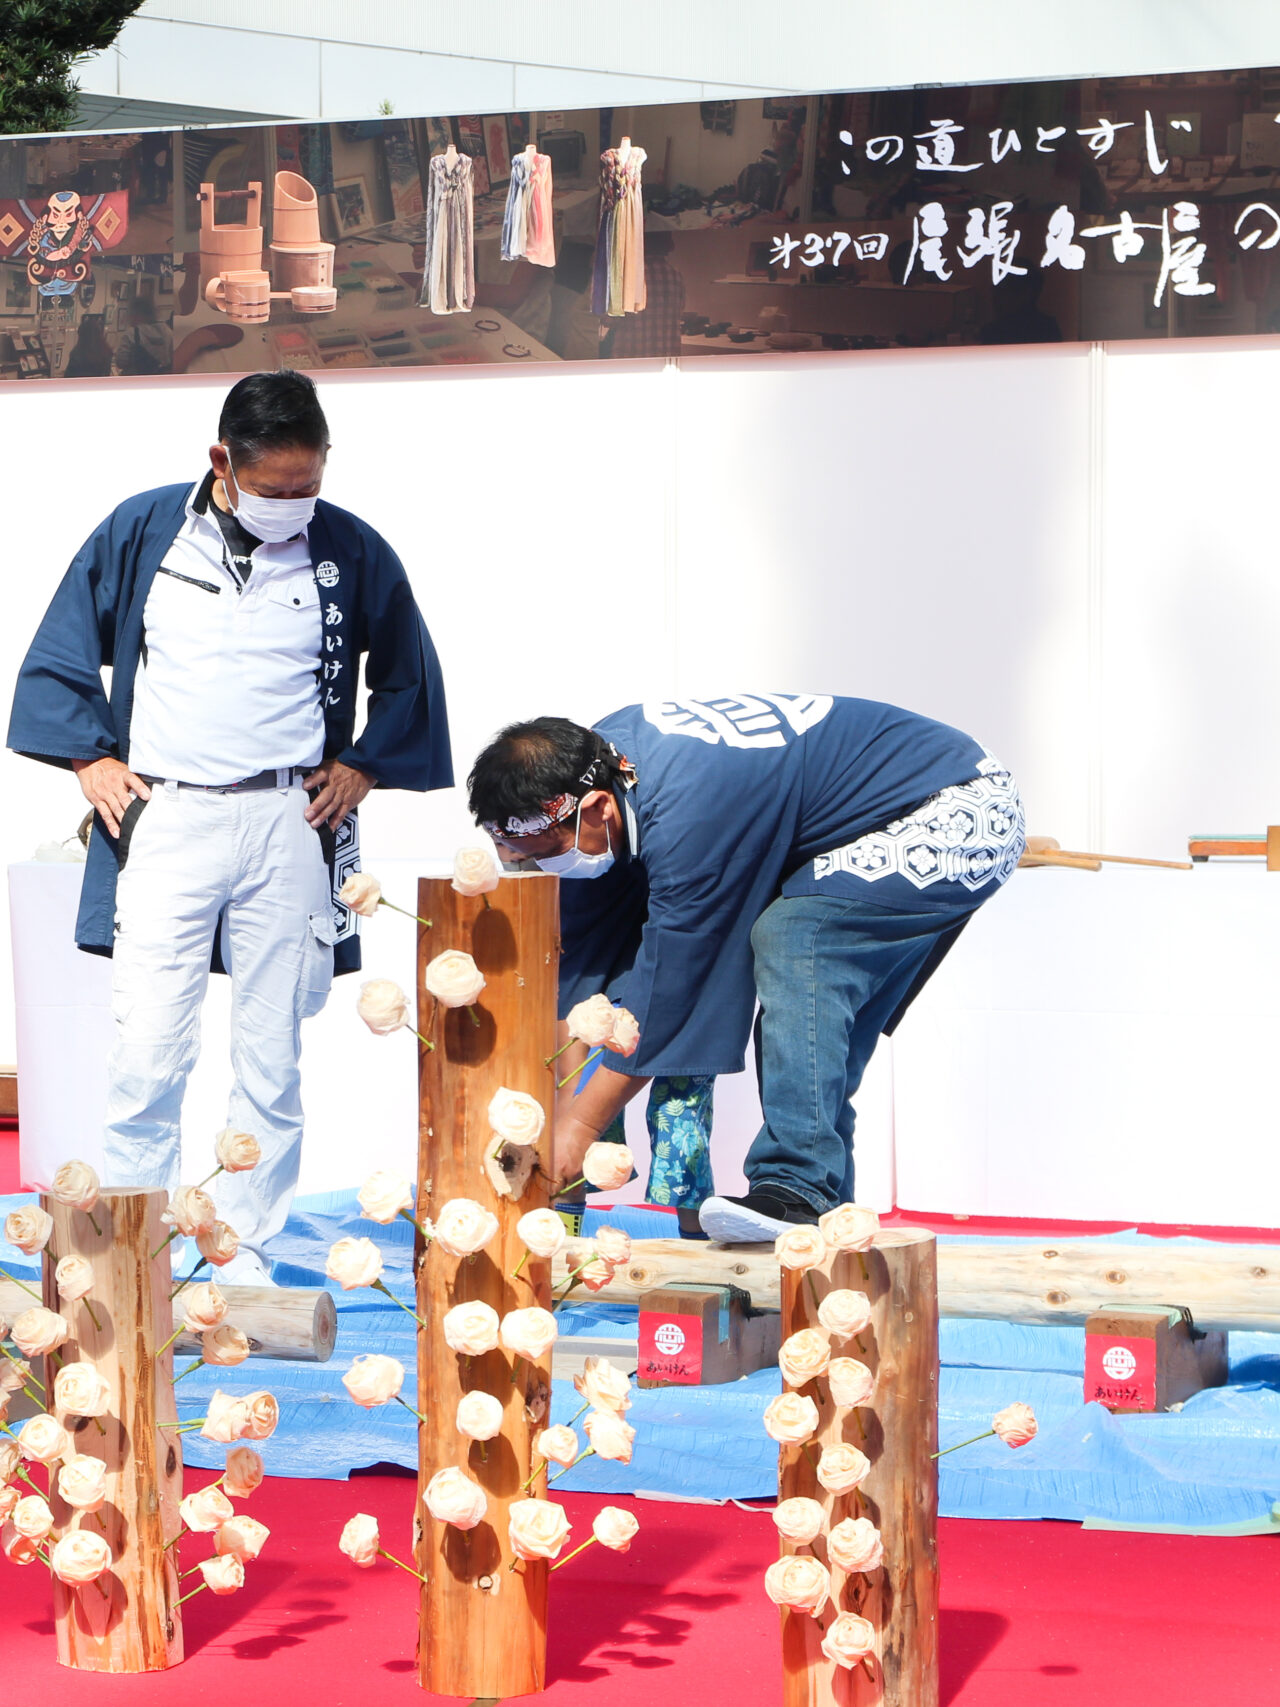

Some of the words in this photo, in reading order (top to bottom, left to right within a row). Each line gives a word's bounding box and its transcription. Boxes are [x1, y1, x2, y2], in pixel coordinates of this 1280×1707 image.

[839, 109, 1193, 175] この道ひとすじ
[324, 602, 343, 709] あいけん
[646, 1361, 689, 1376] あいけん
